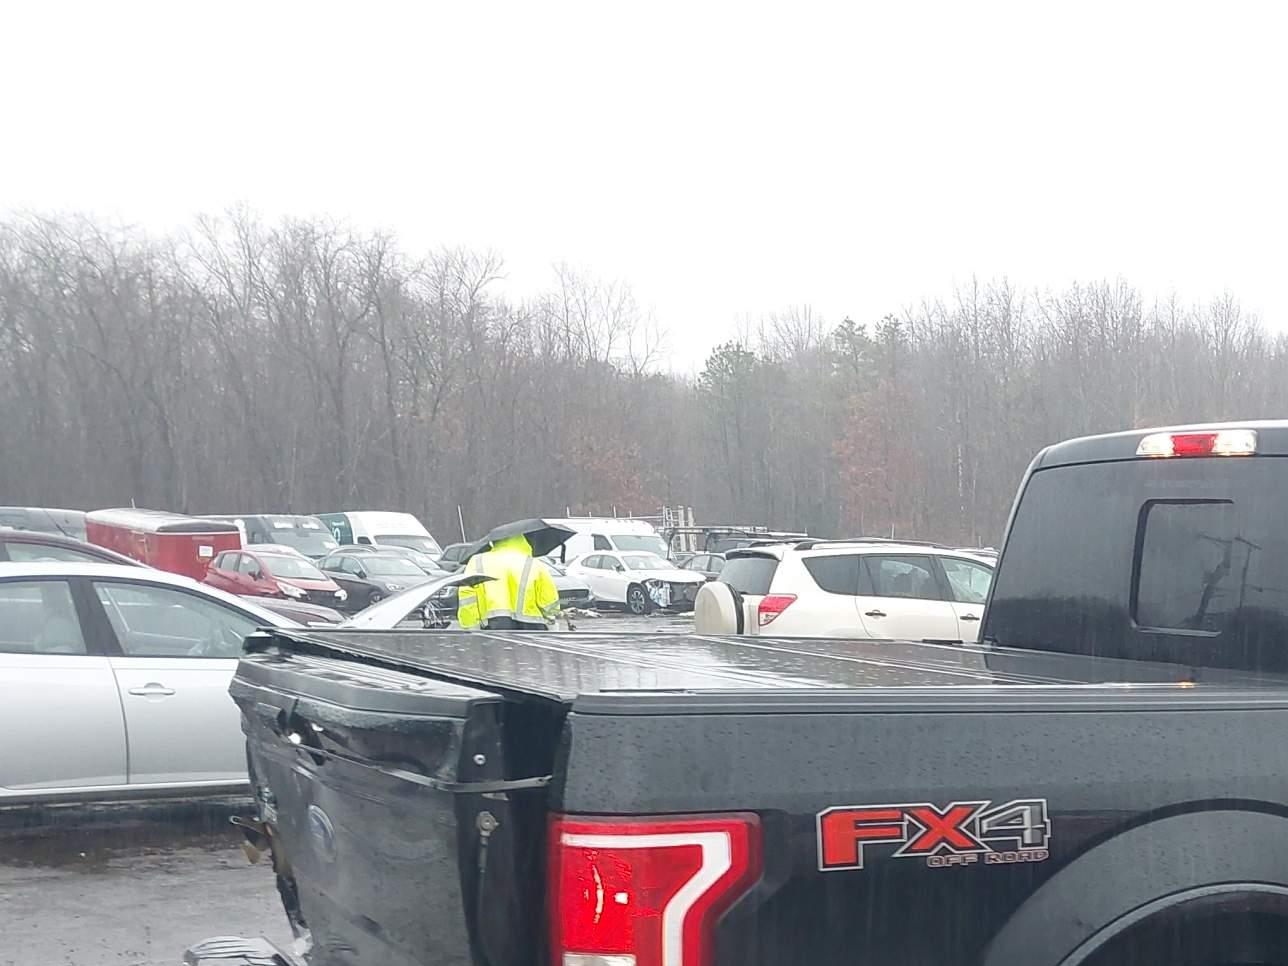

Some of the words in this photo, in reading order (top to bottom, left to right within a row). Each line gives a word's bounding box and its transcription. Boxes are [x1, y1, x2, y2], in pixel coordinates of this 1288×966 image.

[816, 799, 1051, 872] FX4
[926, 855, 978, 868] OFF
[984, 850, 1049, 865] ROAD
